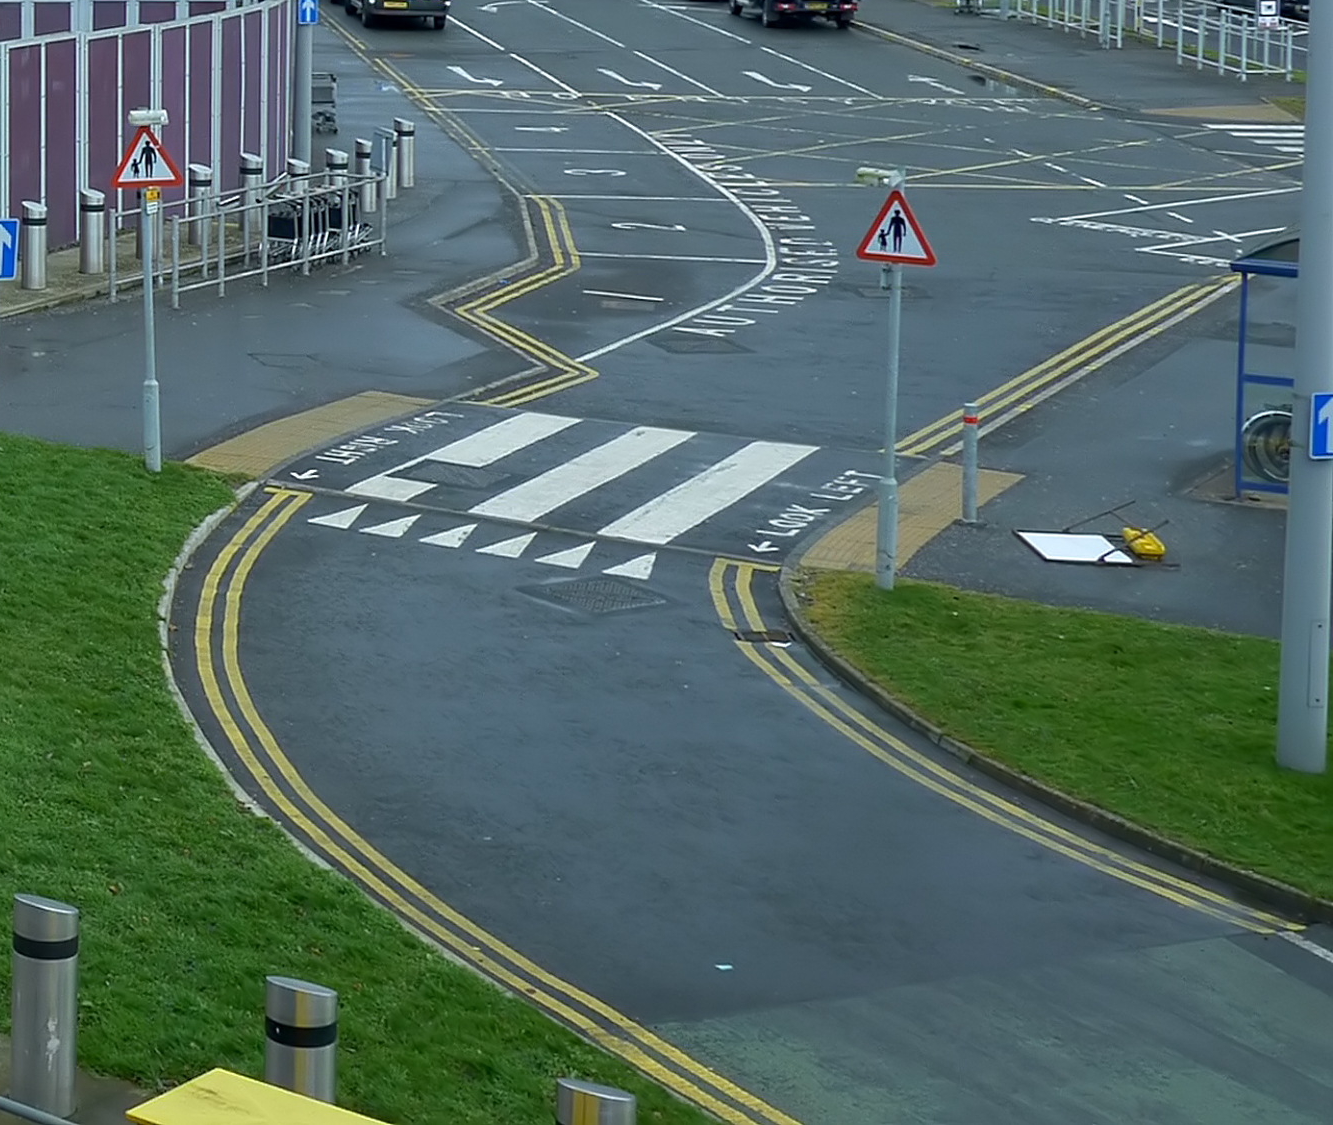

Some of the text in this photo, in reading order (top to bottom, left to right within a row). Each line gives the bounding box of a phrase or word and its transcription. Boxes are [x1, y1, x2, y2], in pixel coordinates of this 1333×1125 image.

[694, 164, 816, 230] VEHICLES
[671, 236, 840, 338] AUTHORISED
[314, 410, 465, 466] LOOK RIGHT
[755, 470, 884, 537] LOOK LEFT
